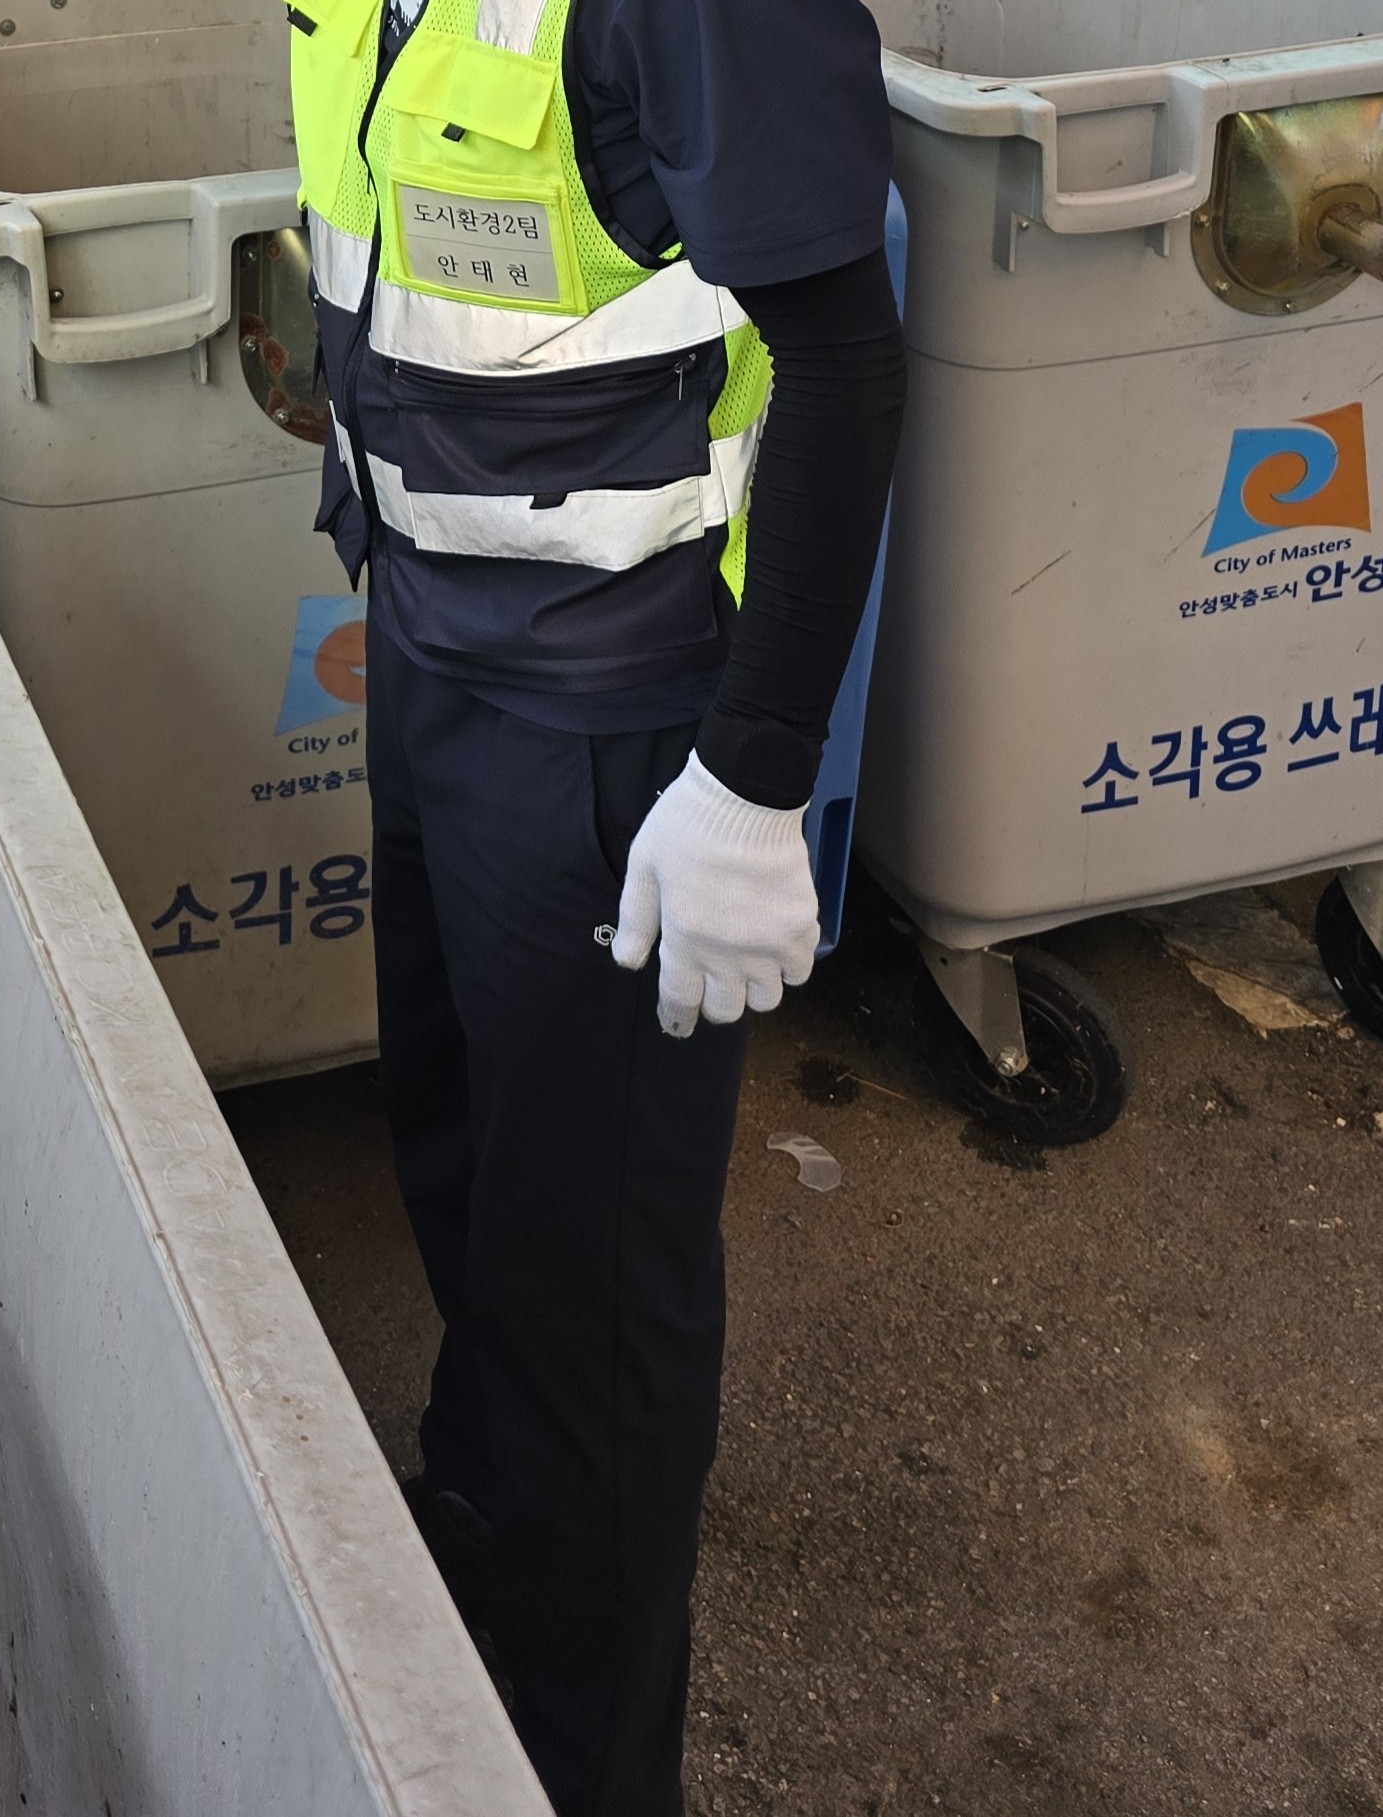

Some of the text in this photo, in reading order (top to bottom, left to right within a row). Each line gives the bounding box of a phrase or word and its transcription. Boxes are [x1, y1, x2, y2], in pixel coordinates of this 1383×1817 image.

[413, 203, 539, 240] 도시환경2팀
[1214, 537, 1352, 574] City of Masters
[1179, 580, 1298, 619] 안성맞춤도시
[288, 727, 359, 754] City of
[1081, 714, 1268, 814] 소각용
[151, 853, 371, 958] 소각용
